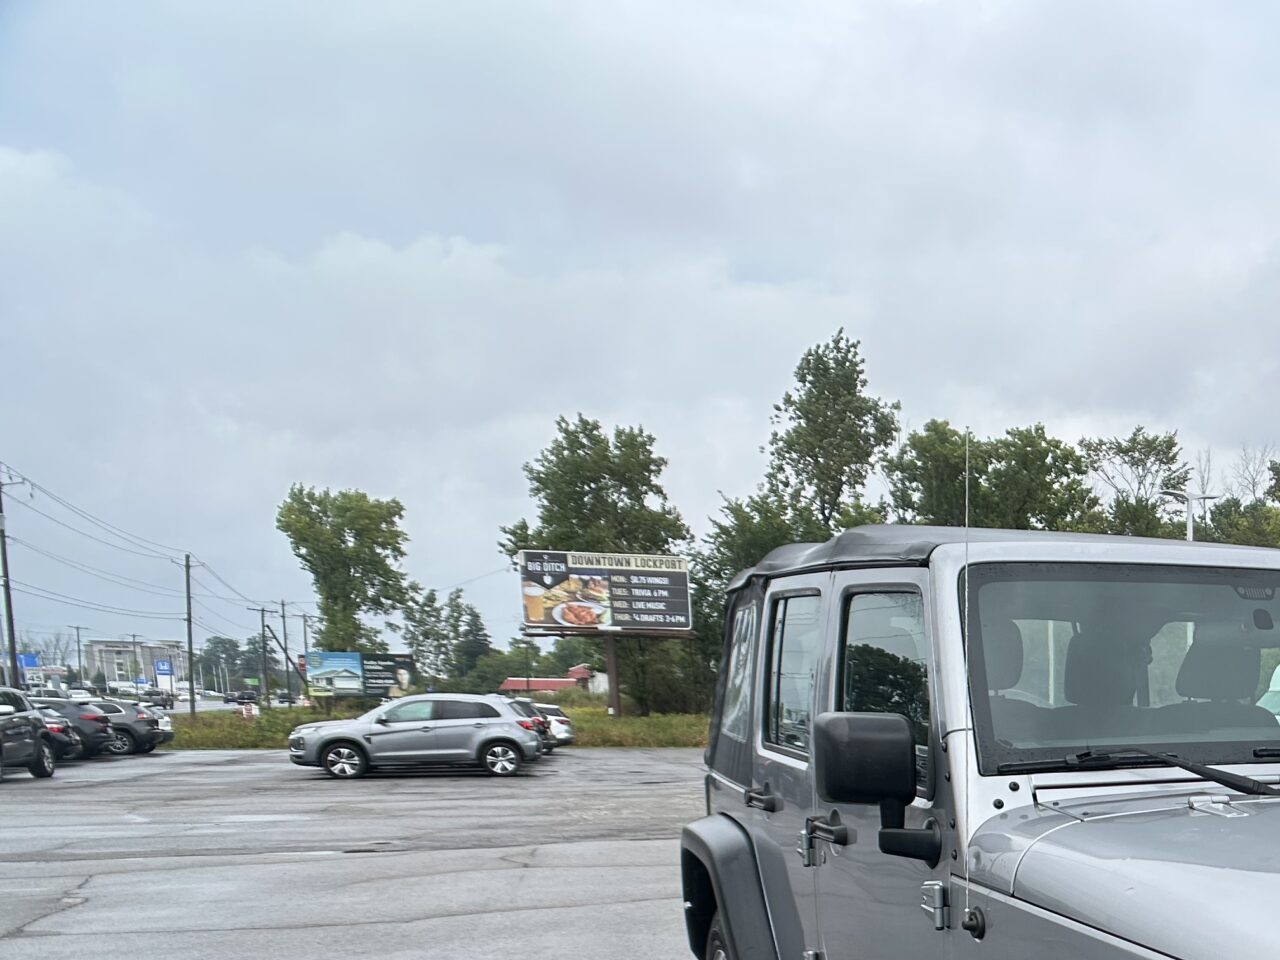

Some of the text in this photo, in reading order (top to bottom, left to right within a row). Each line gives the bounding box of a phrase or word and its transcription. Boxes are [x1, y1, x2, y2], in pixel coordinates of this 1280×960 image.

[527, 561, 566, 572] BIG DITCH
[571, 555, 682, 570] DOWNTOWN LOCKPORT
[631, 588, 652, 597] TRIVIA
[646, 602, 667, 610] MUSIC
[640, 614, 664, 622] DRAFTS
[675, 615, 686, 623] PM
